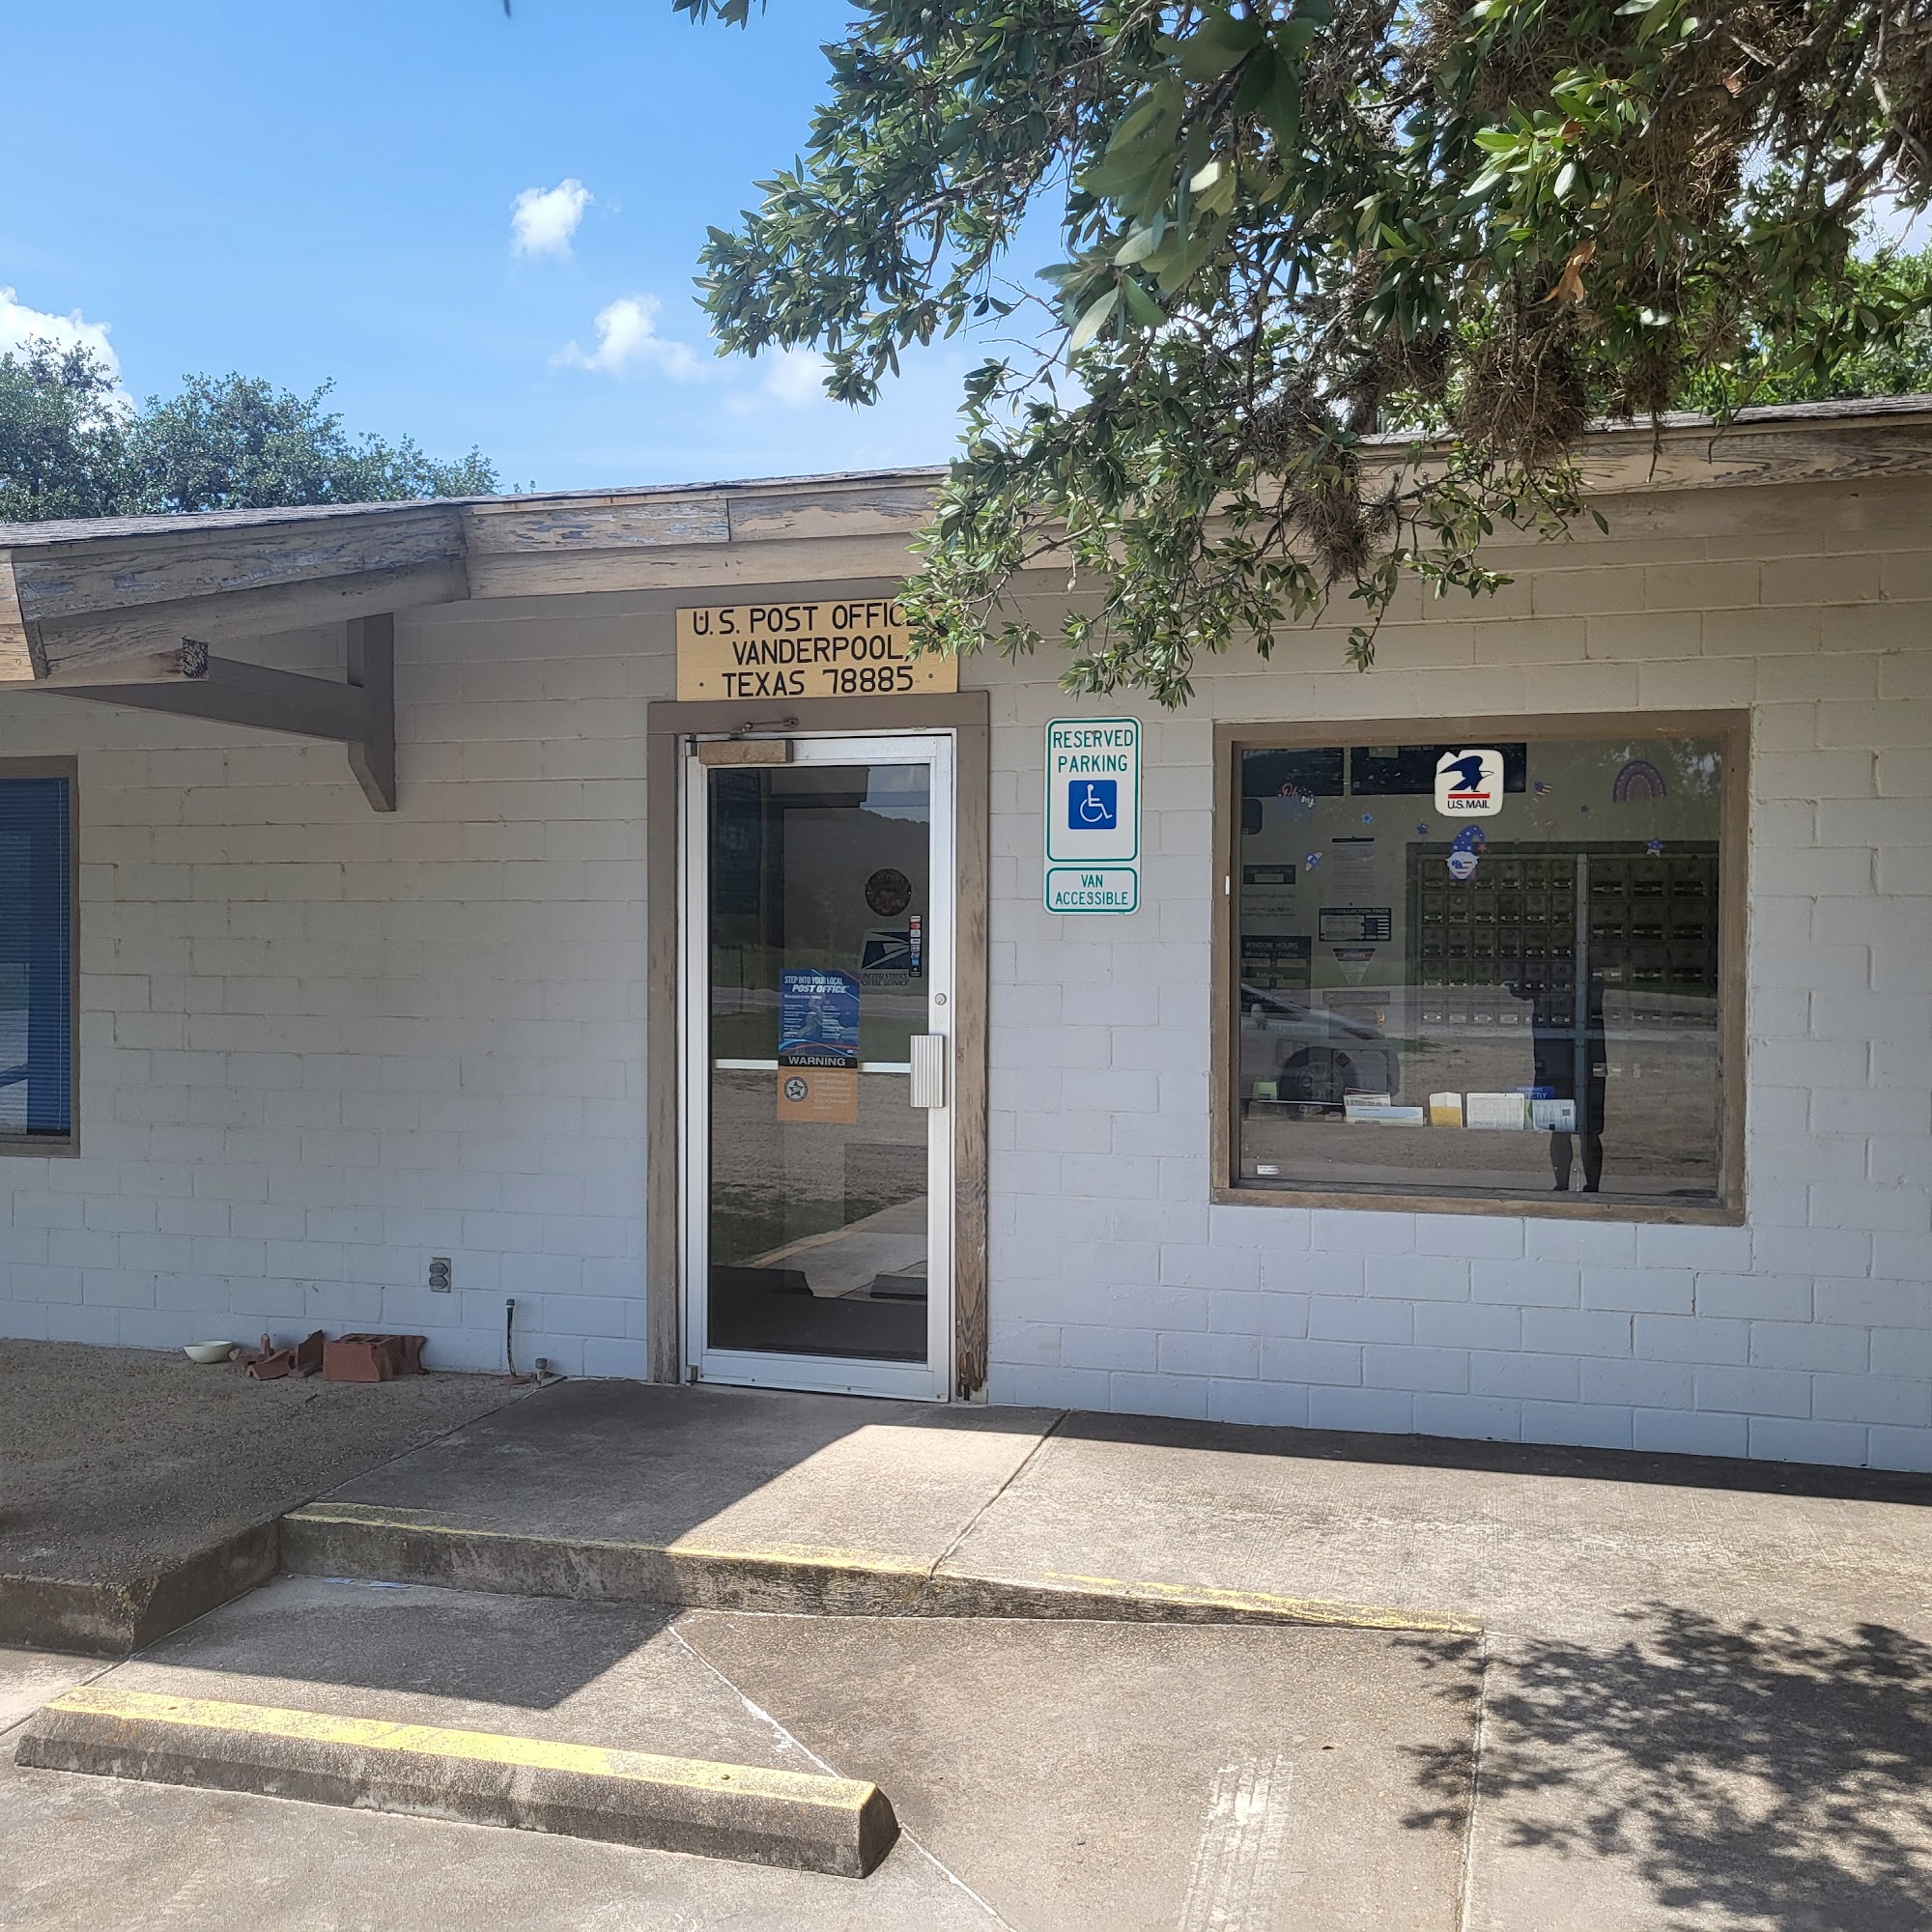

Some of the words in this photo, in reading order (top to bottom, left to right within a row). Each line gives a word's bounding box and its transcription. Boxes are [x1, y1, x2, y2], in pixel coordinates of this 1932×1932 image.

[693, 610, 740, 636] U.S.
[750, 606, 819, 634] POST
[732, 634, 911, 666] VANDERPOOL,
[722, 670, 806, 697] TEXAS
[822, 666, 914, 695] 78885
[1053, 729, 1134, 749] RESERVED
[1058, 754, 1128, 773] PARKING
[1447, 800, 1465, 810] U.S.
[1466, 800, 1491, 809] MAIL
[1081, 874, 1103, 888] VAN
[1055, 892, 1128, 905] ACCESSIBLE
[783, 976, 798, 984] STEP
[799, 976, 810, 984] INTO
[827, 977, 843, 985] LOCAL
[792, 984, 815, 993] POST
[788, 1056, 846, 1066] WARNING
